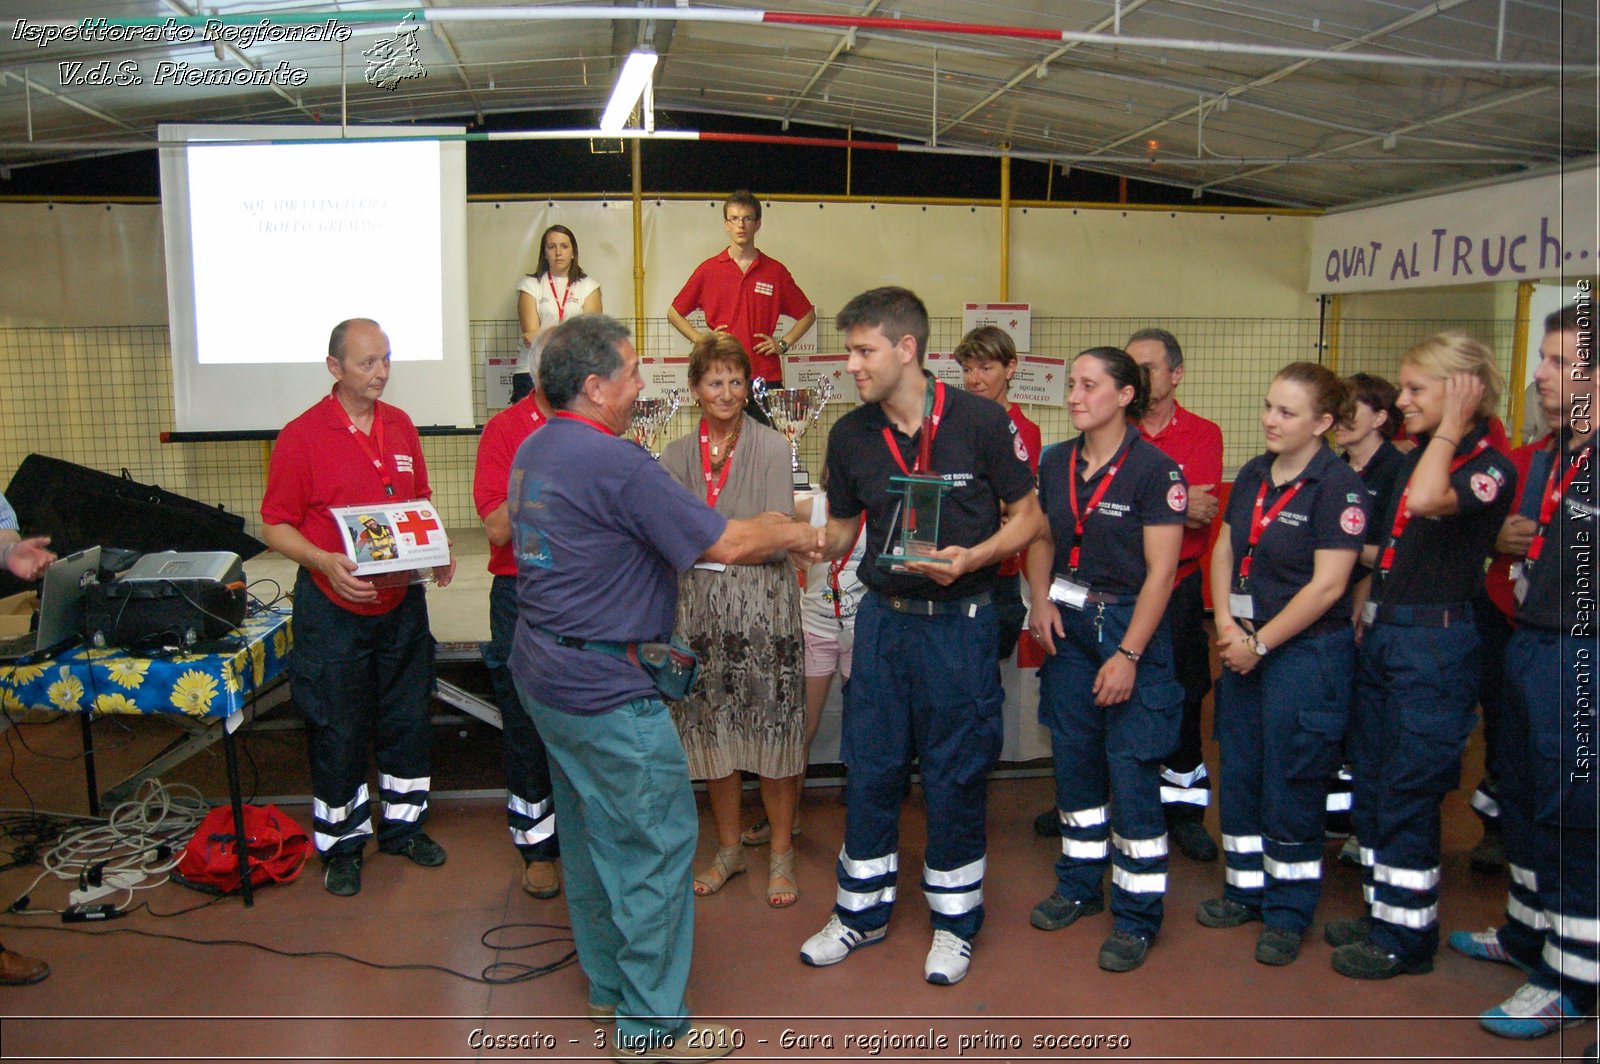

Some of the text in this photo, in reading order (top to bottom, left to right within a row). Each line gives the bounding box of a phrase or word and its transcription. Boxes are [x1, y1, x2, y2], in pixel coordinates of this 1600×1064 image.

[1325, 241, 1382, 283] QUAT
[1390, 242, 1420, 281] AL
[1018, 384, 1047, 393] SQUADRA
[1013, 392, 1050, 402] MONCALVO
